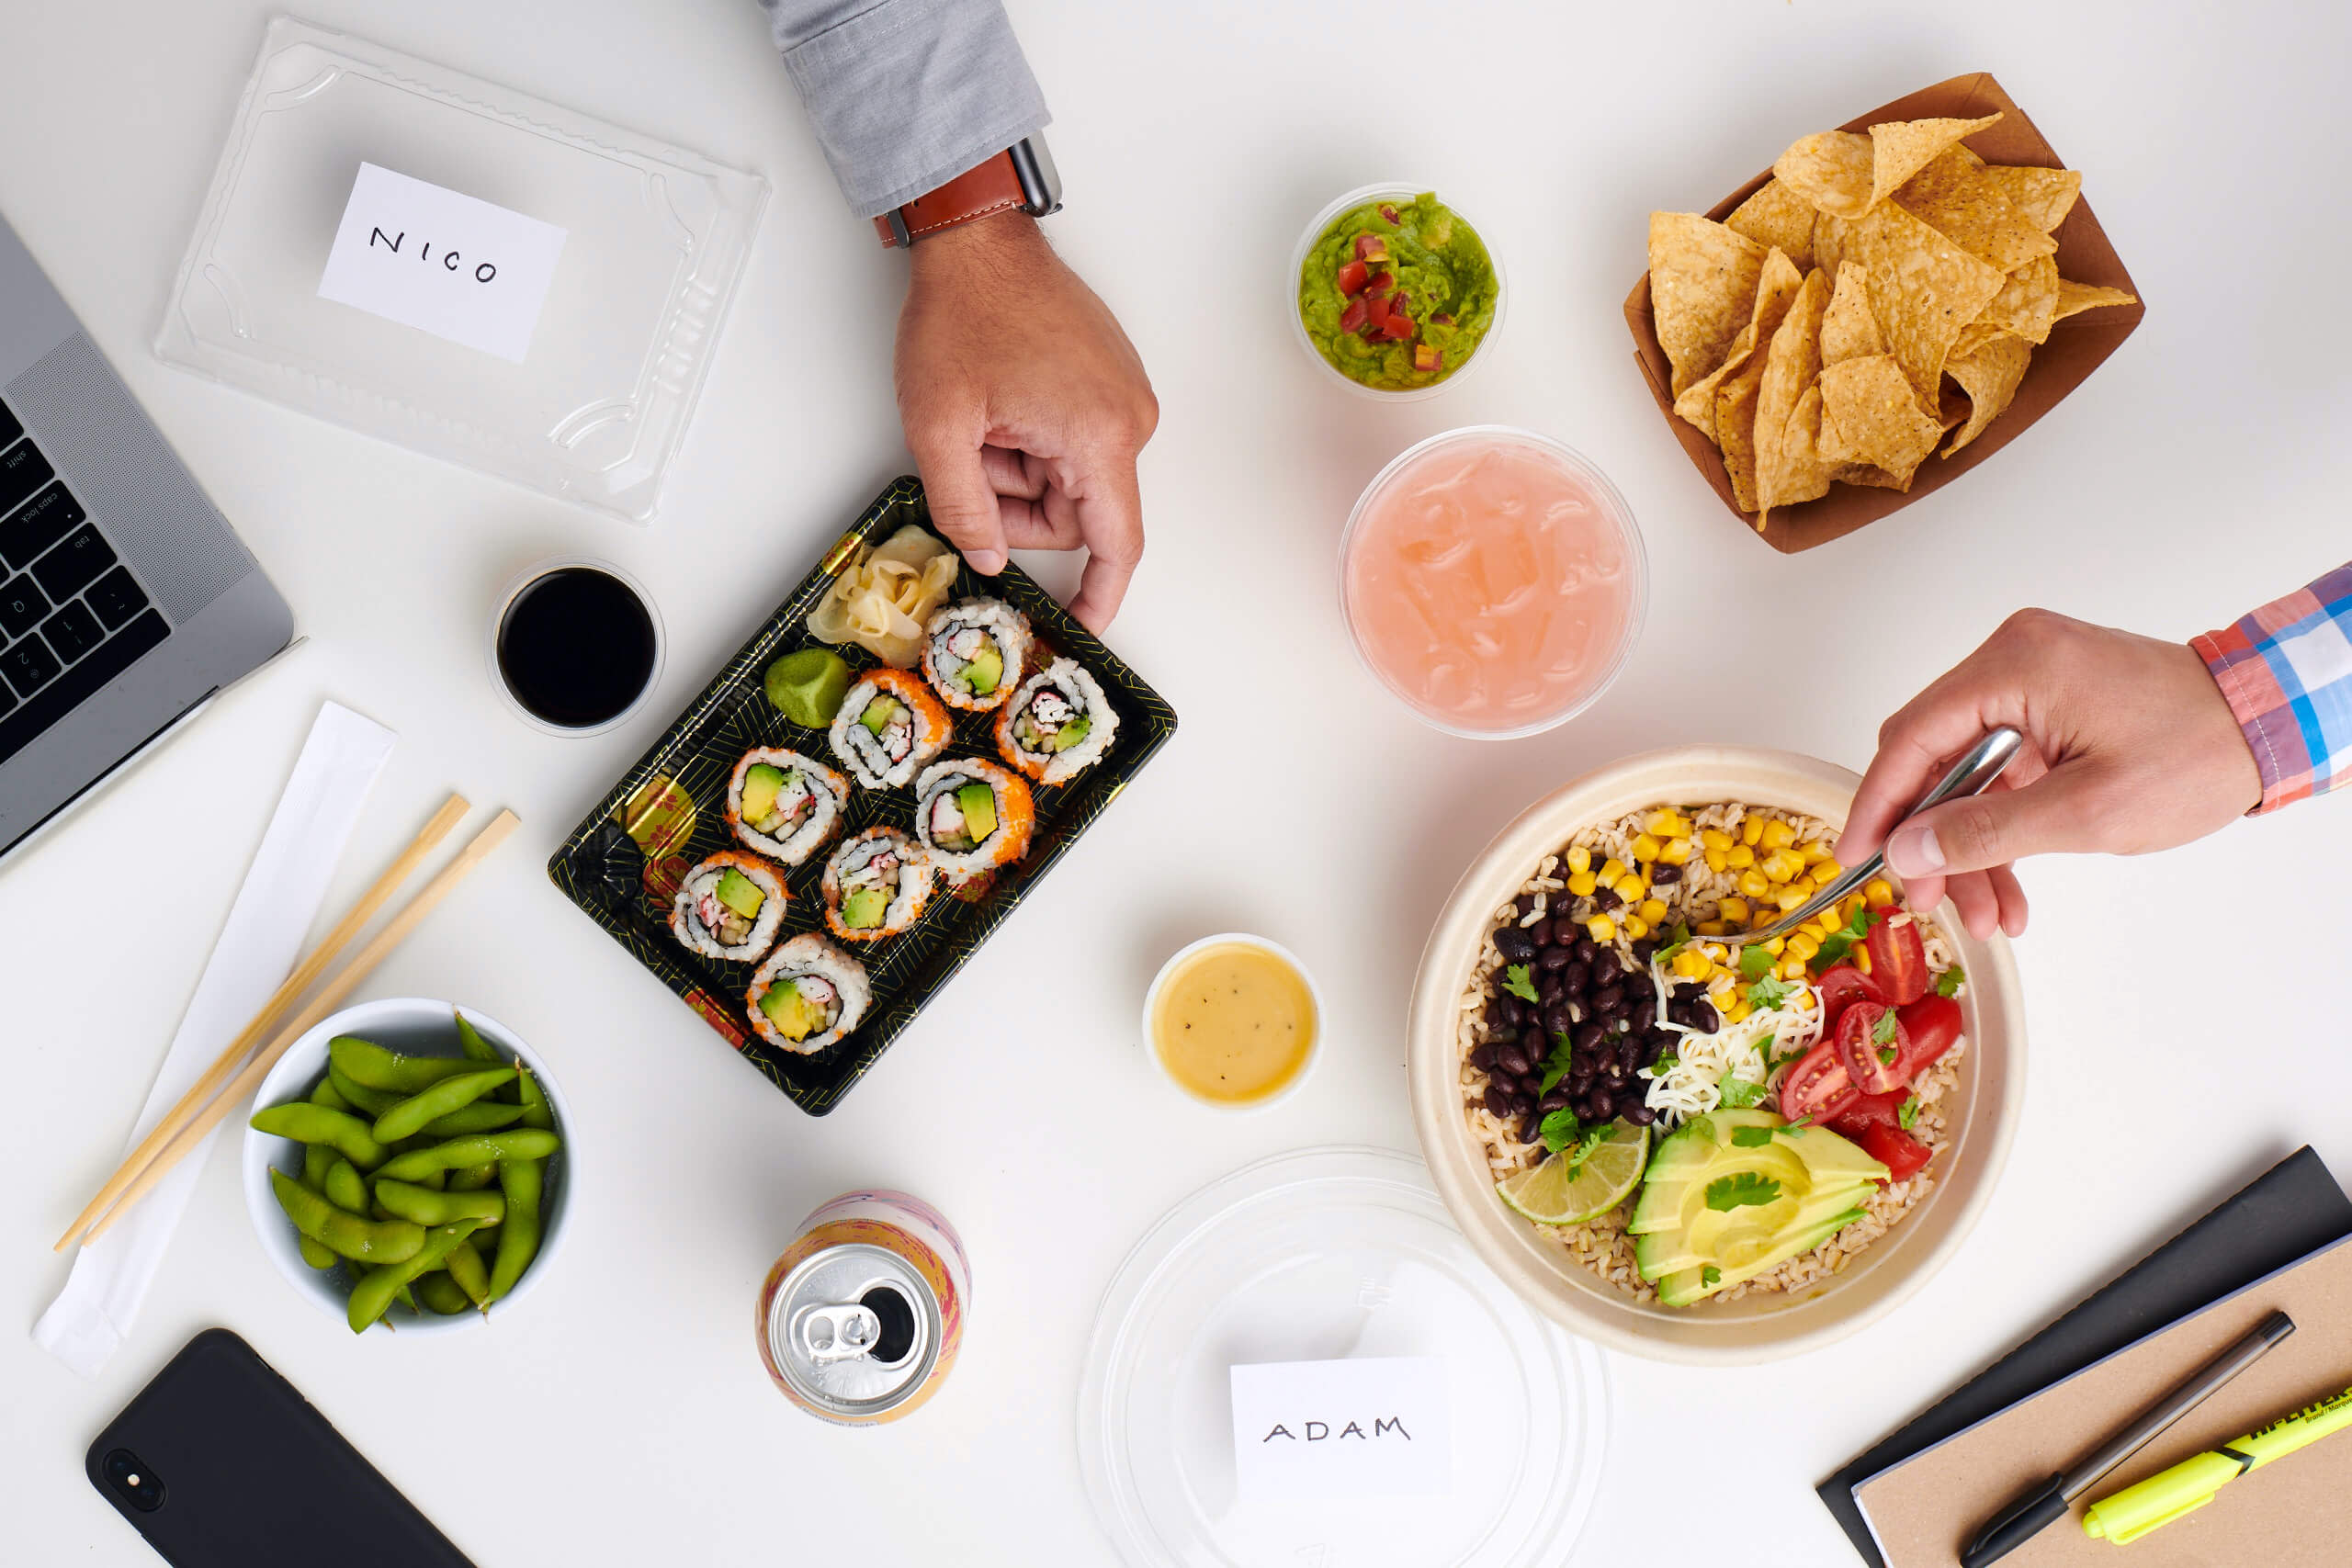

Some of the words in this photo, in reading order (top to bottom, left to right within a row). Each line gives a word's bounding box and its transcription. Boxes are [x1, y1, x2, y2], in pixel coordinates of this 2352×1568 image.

[370, 227, 496, 283] NICO
[6, 450, 27, 468] shift
[38, 492, 58, 510] caps
[21, 507, 40, 524] lock
[74, 536, 90, 548] tab
[11, 600, 25, 613] Q
[62, 621, 73, 631] 1
[17, 652, 29, 665] 2
[1262, 1416, 1411, 1443] ADAM
